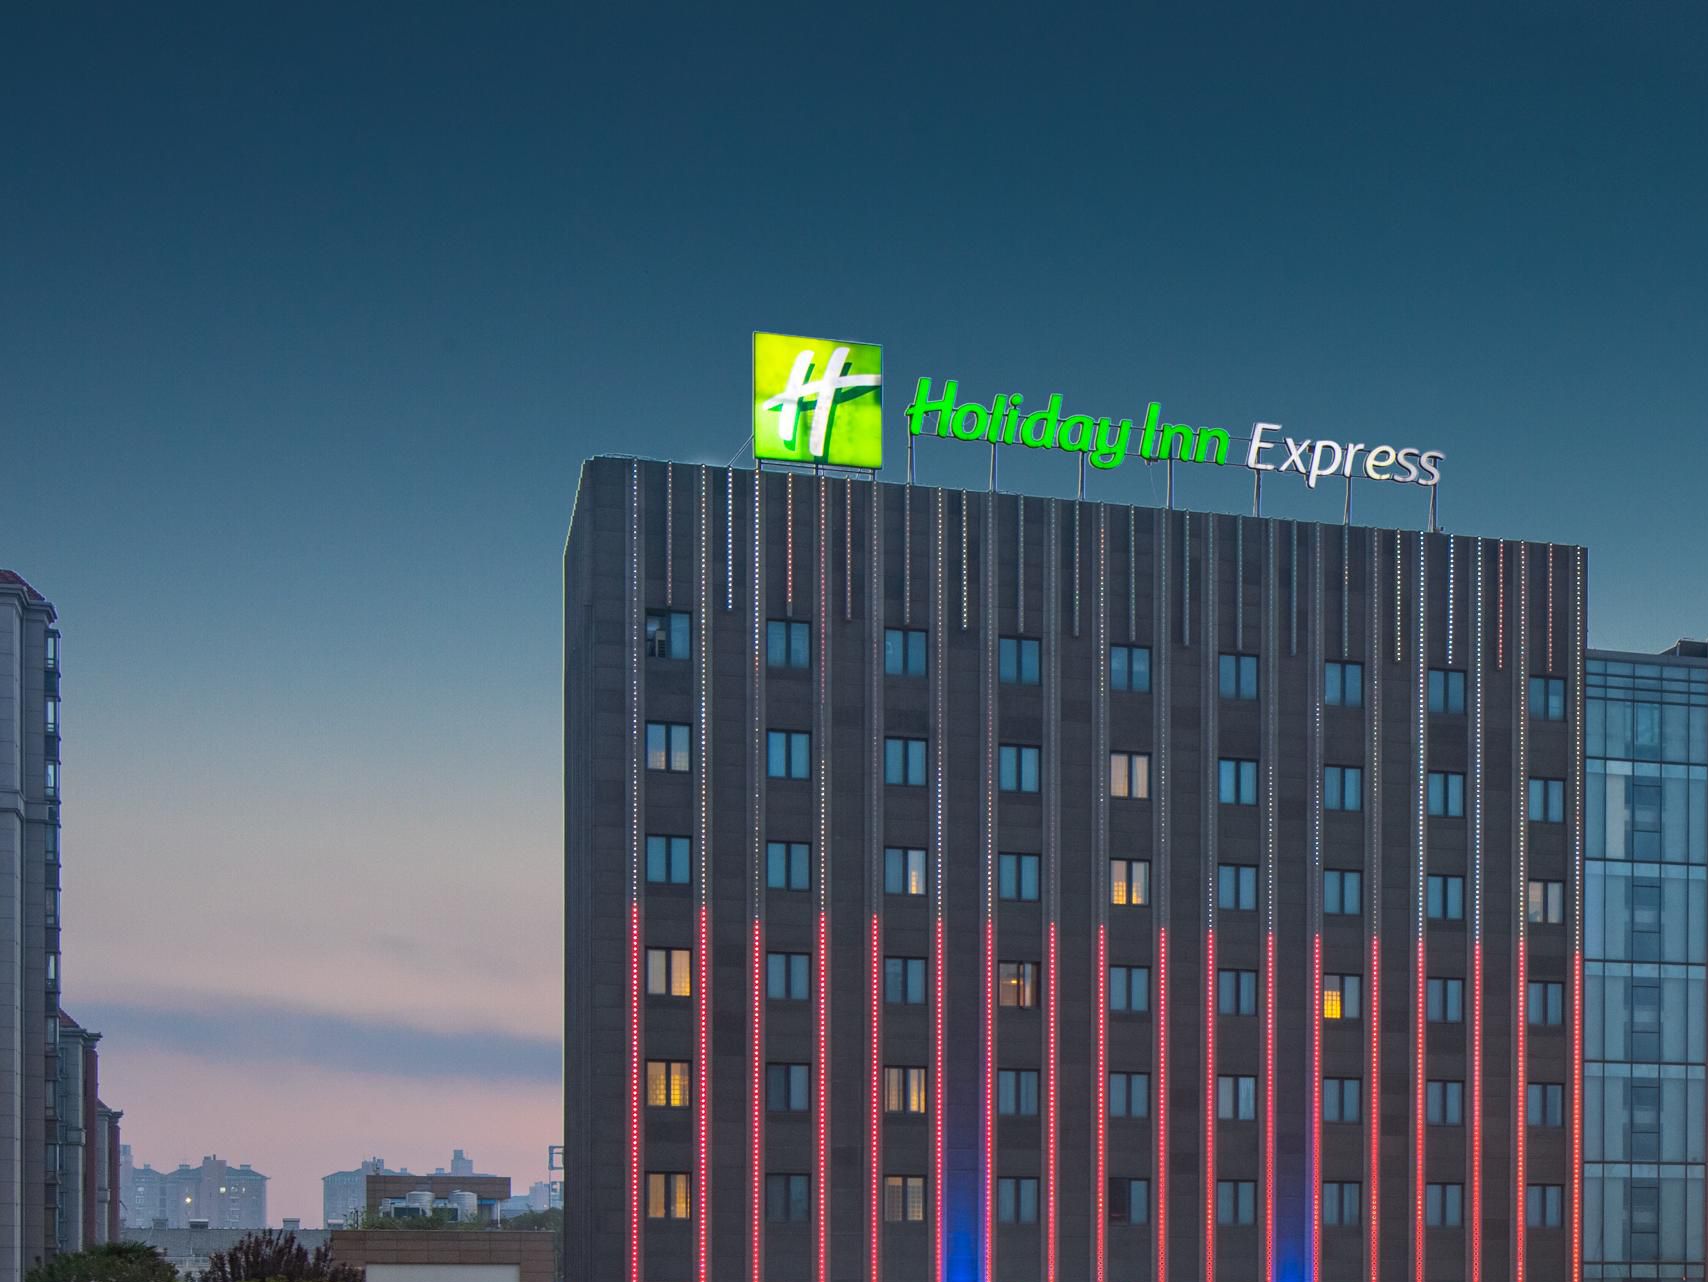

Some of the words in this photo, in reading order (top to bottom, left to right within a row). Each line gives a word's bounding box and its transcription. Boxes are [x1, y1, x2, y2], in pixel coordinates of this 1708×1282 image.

[906, 376, 1132, 471] Holiday
[1140, 401, 1229, 466] Inn
[1247, 422, 1446, 489] Express
